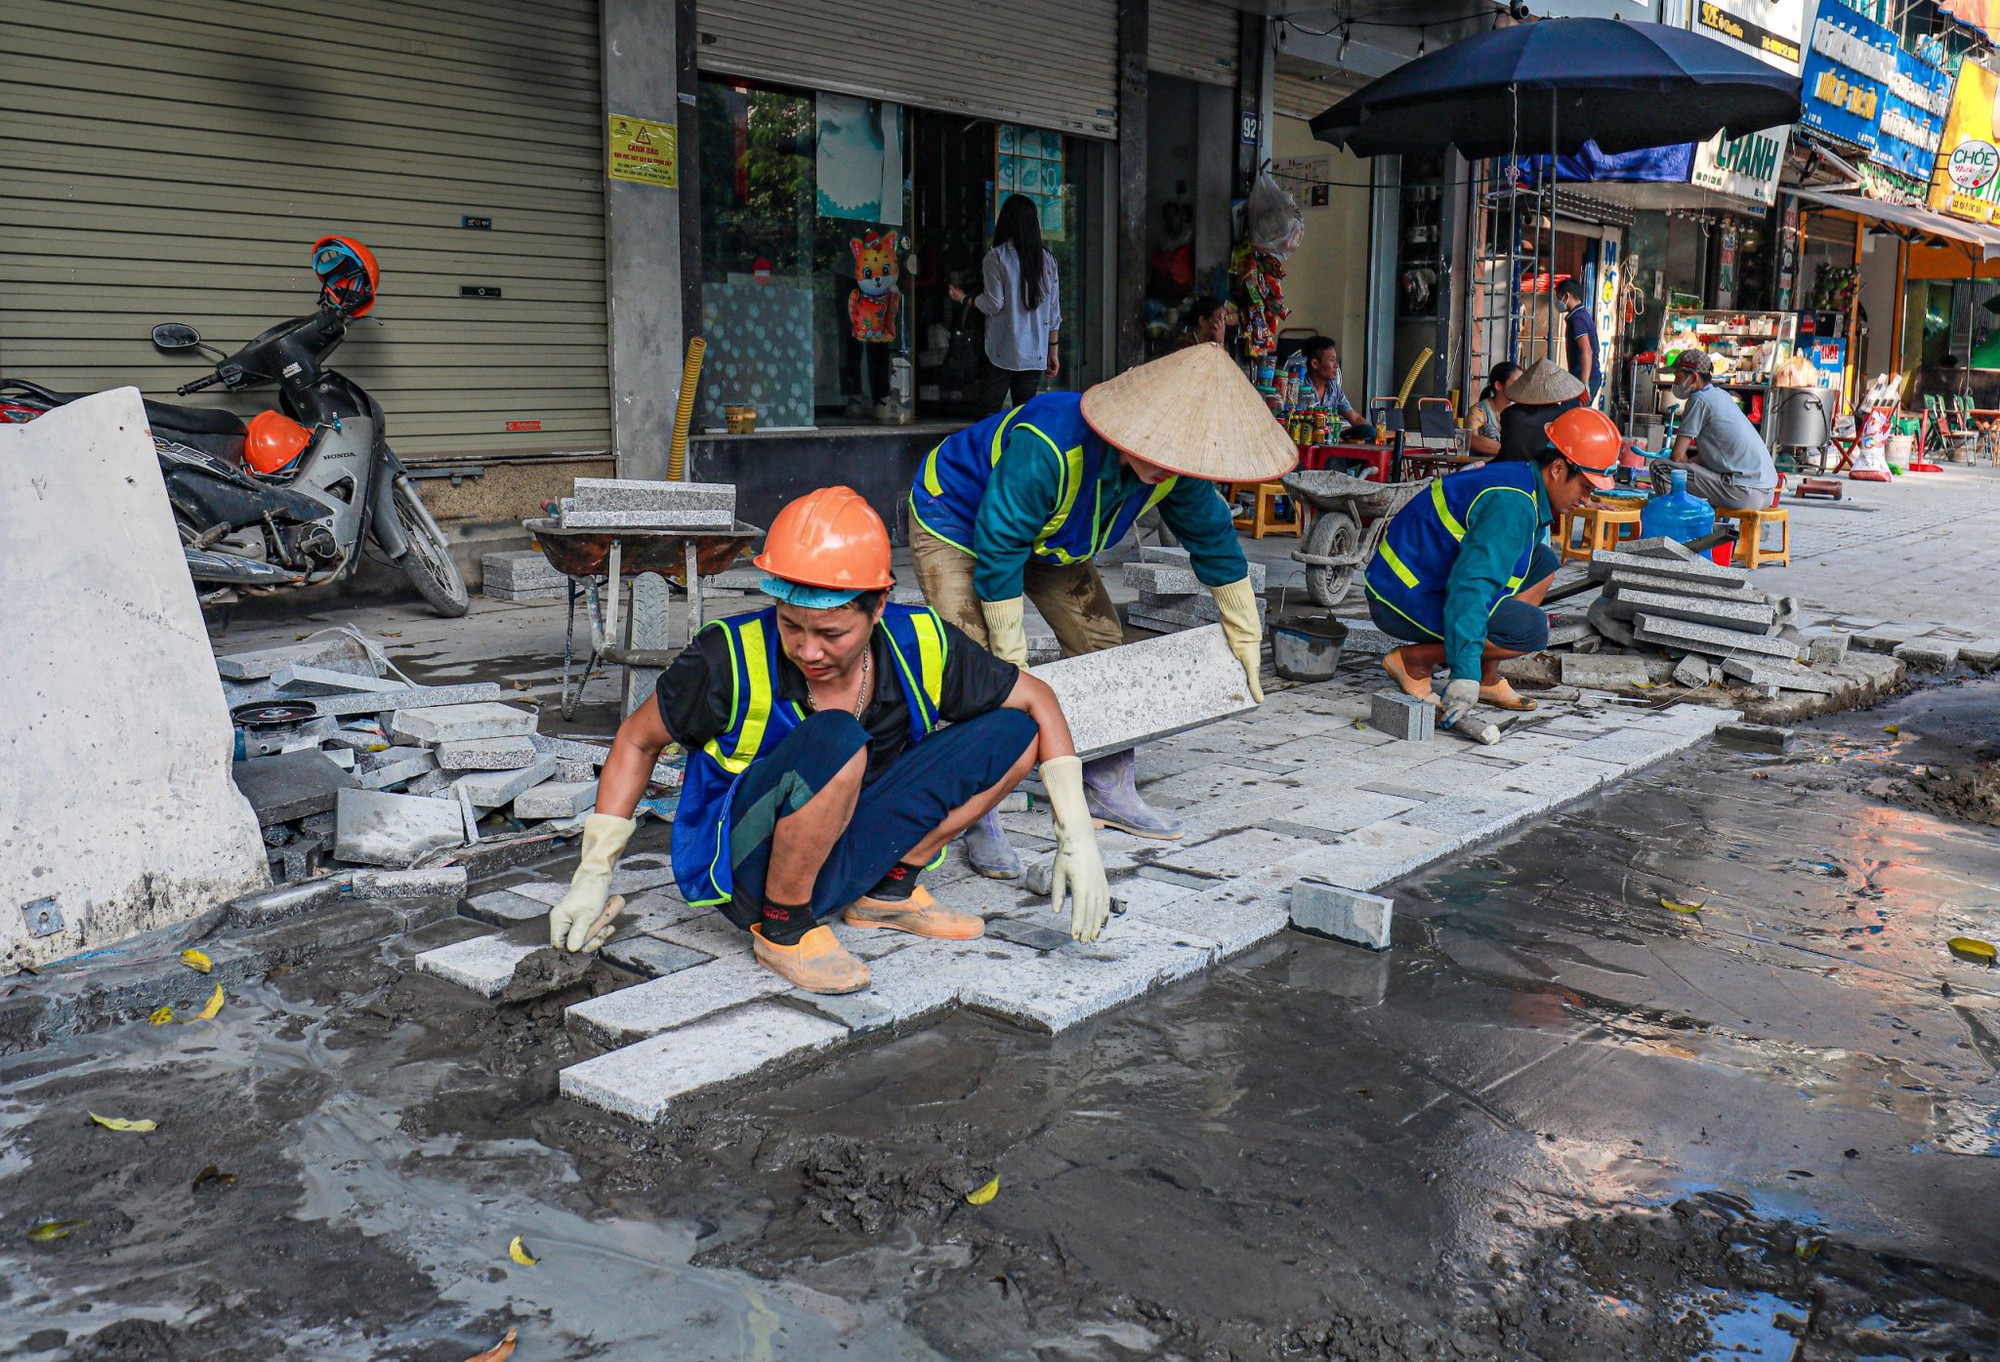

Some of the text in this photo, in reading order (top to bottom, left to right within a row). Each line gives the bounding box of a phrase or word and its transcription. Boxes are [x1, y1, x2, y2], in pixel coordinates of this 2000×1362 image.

[1243, 118, 1256, 138] 92
[1716, 127, 1779, 181] CHANH
[1954, 148, 1996, 166] CHÓE
[323, 452, 357, 460] HONDA
